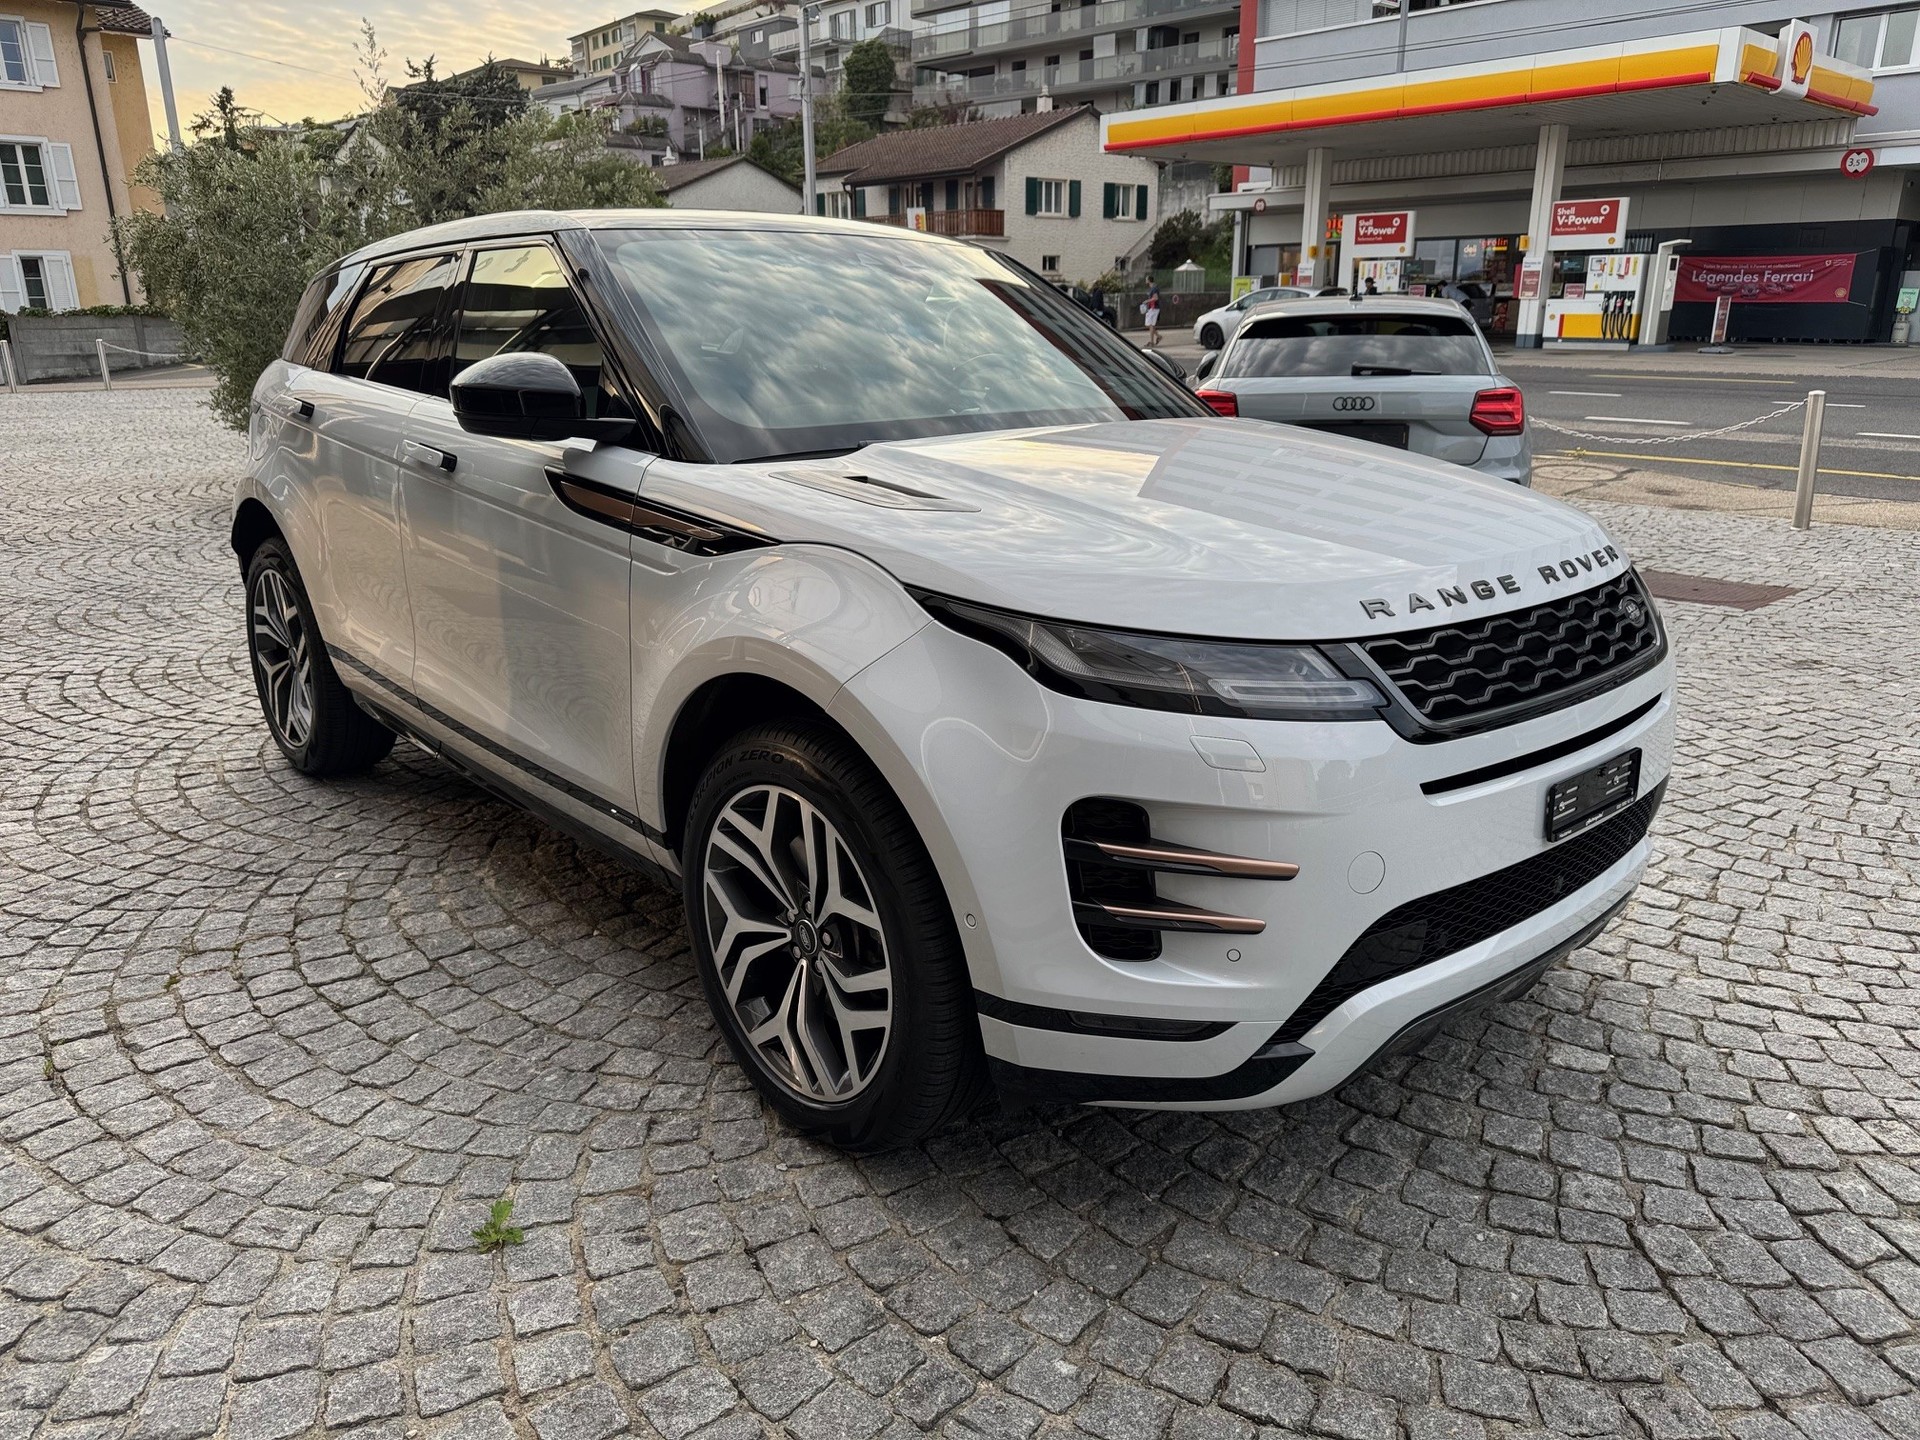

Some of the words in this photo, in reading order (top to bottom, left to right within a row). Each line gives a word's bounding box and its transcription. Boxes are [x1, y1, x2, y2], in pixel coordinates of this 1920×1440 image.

[1557, 206, 1576, 215] Shell
[1359, 218, 1373, 226] Shell
[1557, 215, 1605, 226] V-Power
[1359, 226, 1397, 236] V-Power
[1692, 269, 1759, 284] Légendes
[1763, 269, 1814, 283] Ferrari
[1359, 574, 1521, 619] RANGE
[1537, 544, 1619, 585] ROVER
[739, 749, 785, 764] ZERO
